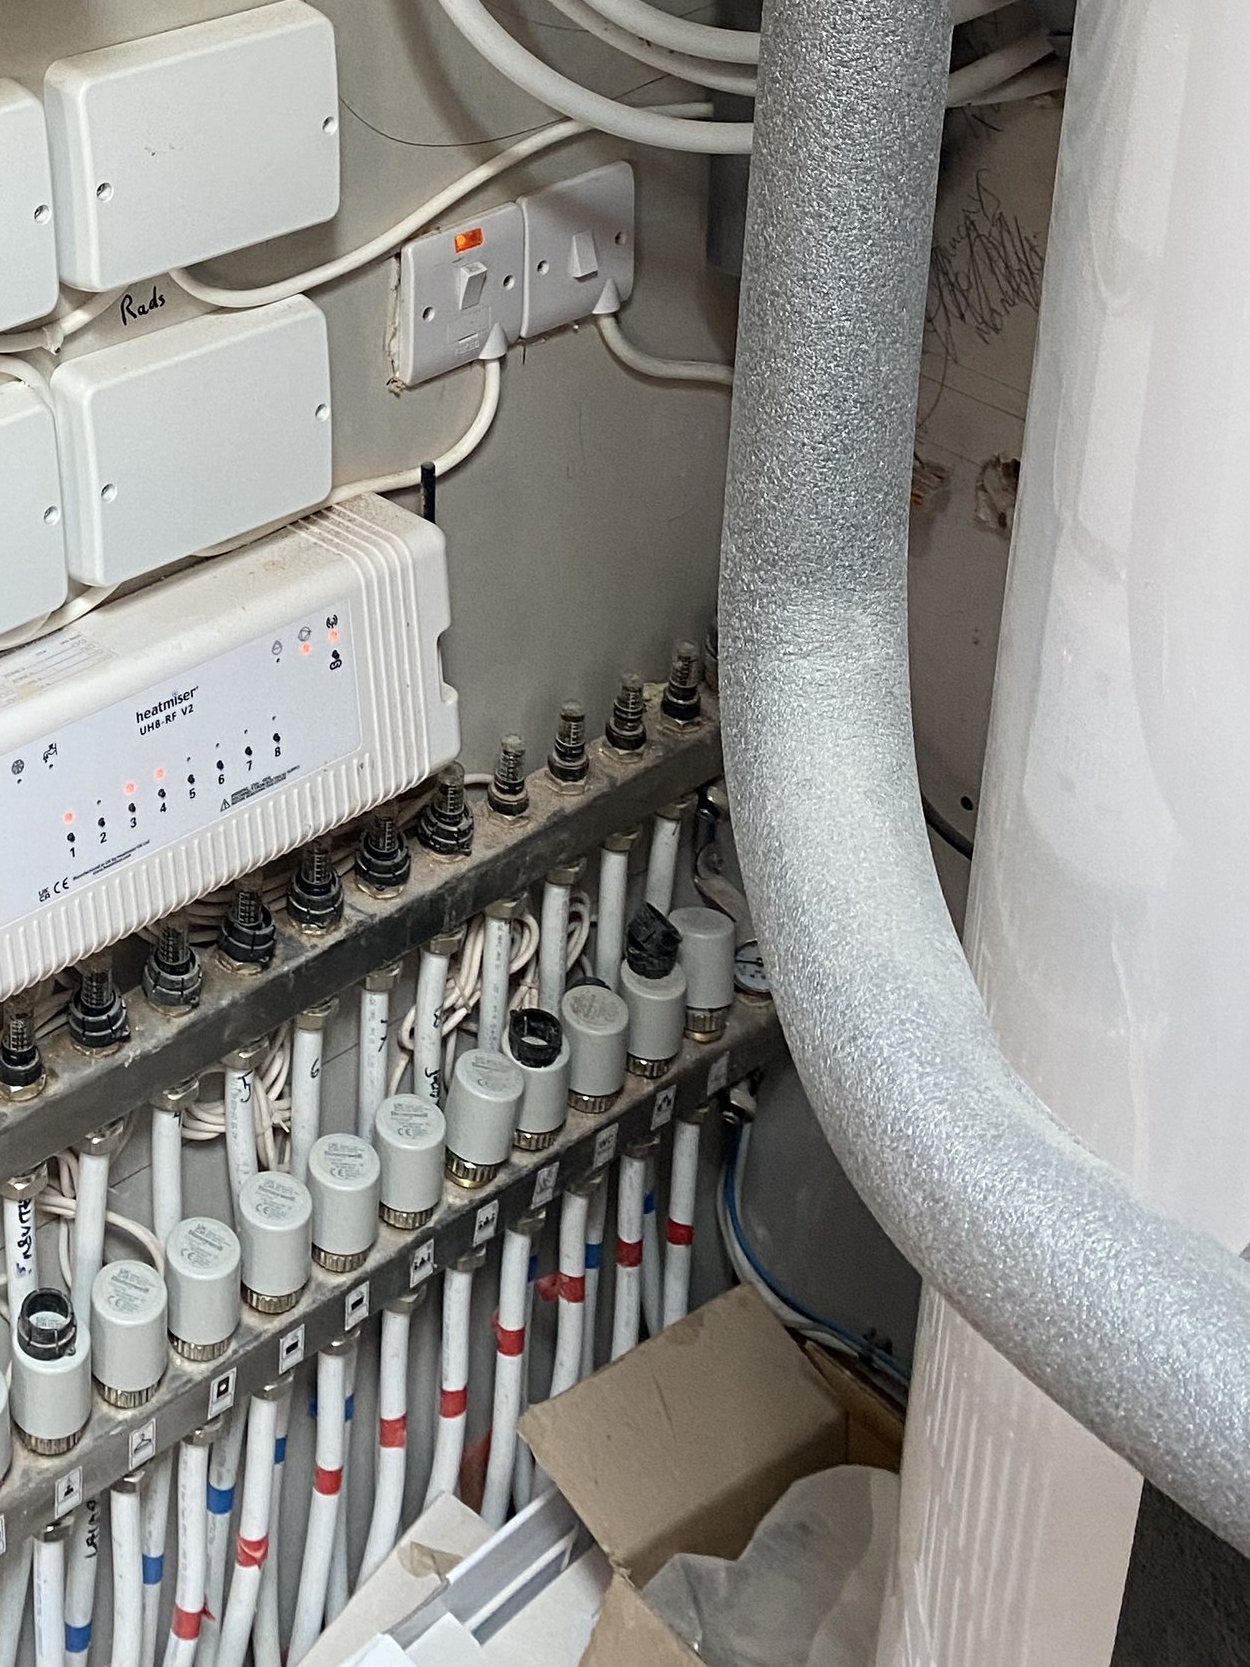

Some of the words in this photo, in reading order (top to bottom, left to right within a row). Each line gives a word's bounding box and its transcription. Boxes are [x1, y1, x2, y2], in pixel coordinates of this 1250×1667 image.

[119, 292, 167, 326] Rads
[135, 686, 197, 724] heatmiser
[139, 710, 178, 736] UH8-RF
[180, 703, 194, 716] V2
[68, 846, 76, 859] 1
[99, 831, 108, 844] 2
[129, 816, 138, 829] 3
[159, 802, 168, 814] 4
[188, 787, 197, 800] 5
[217, 773, 226, 785] 6
[245, 759, 253, 772] 7
[273, 745, 282, 758] 8
[310, 1056, 321, 1079] 6
[237, 1069, 254, 1103] 5
